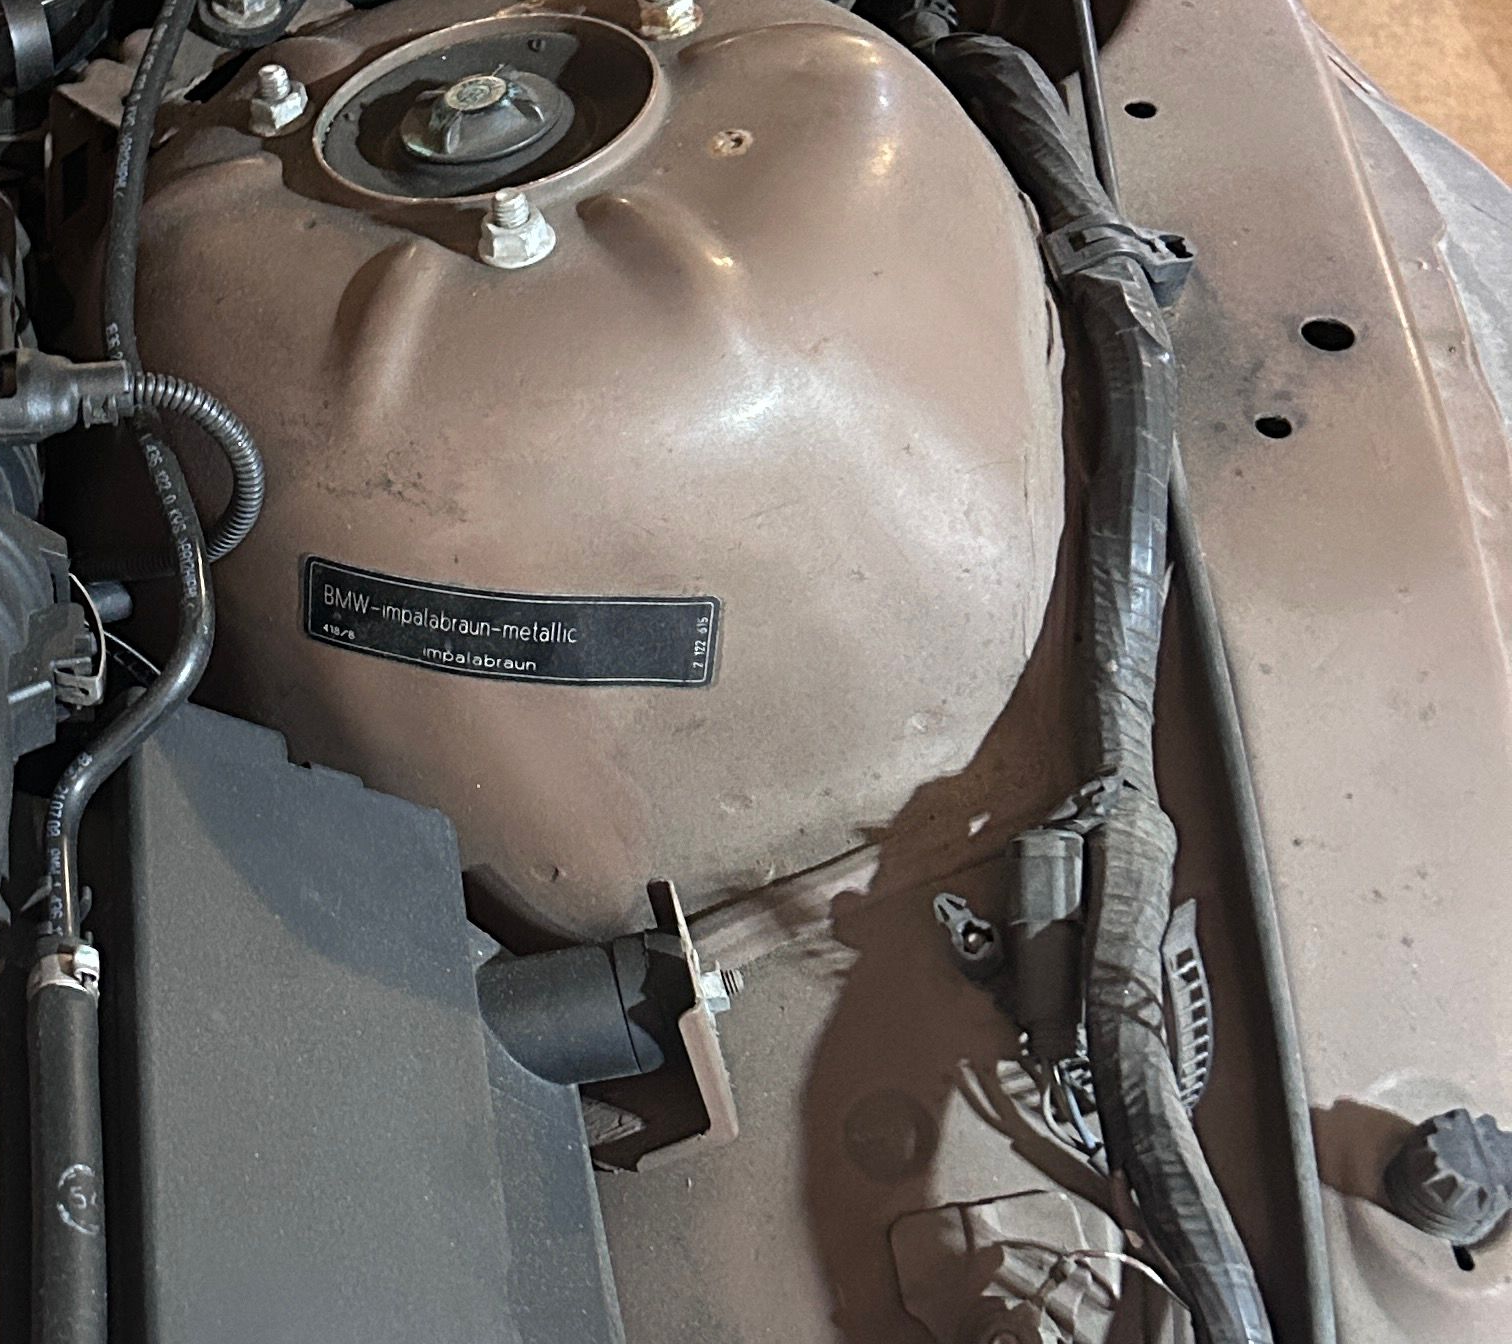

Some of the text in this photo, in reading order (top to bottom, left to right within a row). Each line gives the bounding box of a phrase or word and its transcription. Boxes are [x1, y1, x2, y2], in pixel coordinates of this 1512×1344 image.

[323, 583, 578, 644] BMW-impalabraun-metallic
[696, 616, 709, 634] 615
[422, 646, 537, 672] impalabraun
[693, 640, 707, 656] 122
